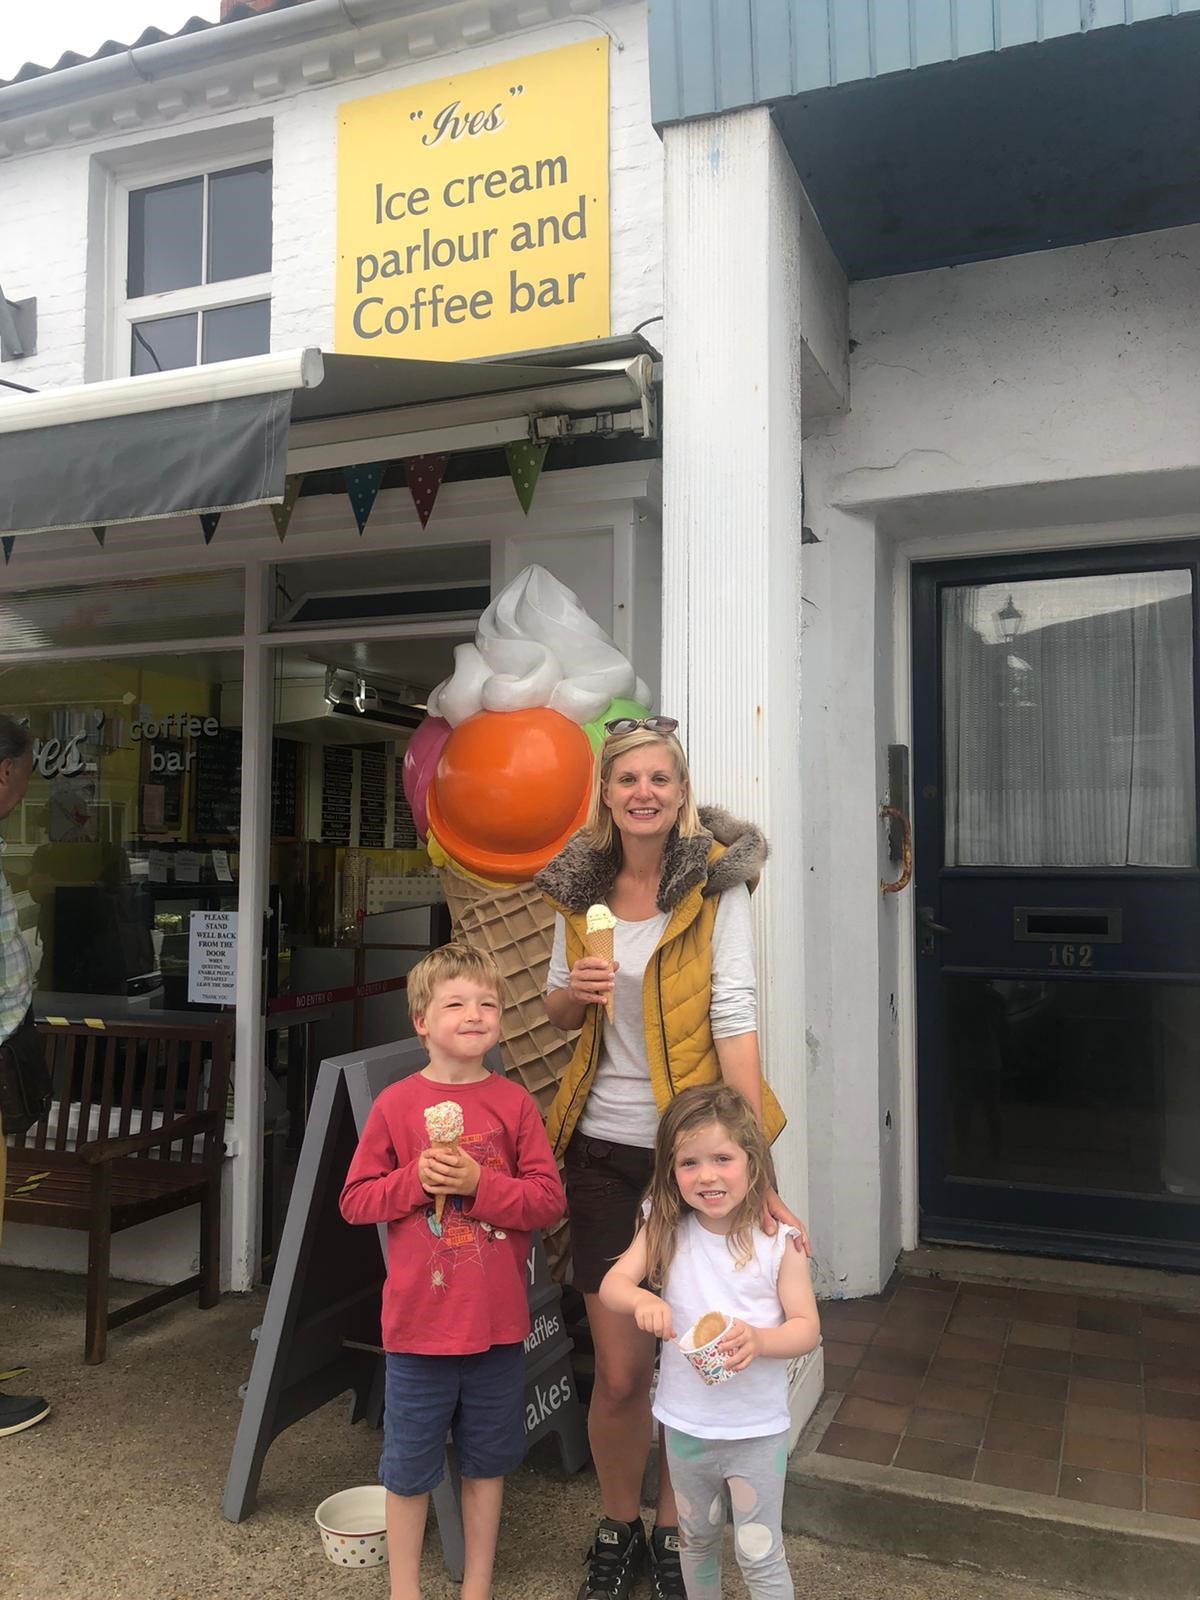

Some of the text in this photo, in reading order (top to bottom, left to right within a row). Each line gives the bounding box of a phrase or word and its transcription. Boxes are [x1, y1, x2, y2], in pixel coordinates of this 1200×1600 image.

[375, 155, 568, 224] Ice cream
[356, 194, 587, 294] parlour and
[352, 270, 586, 339] Coffee bar
[128, 712, 220, 742] coffee
[150, 745, 197, 772] bar
[196, 931, 216, 939] WELL
[1048, 944, 1093, 967] 162
[296, 993, 326, 1008] NO ENTRY
